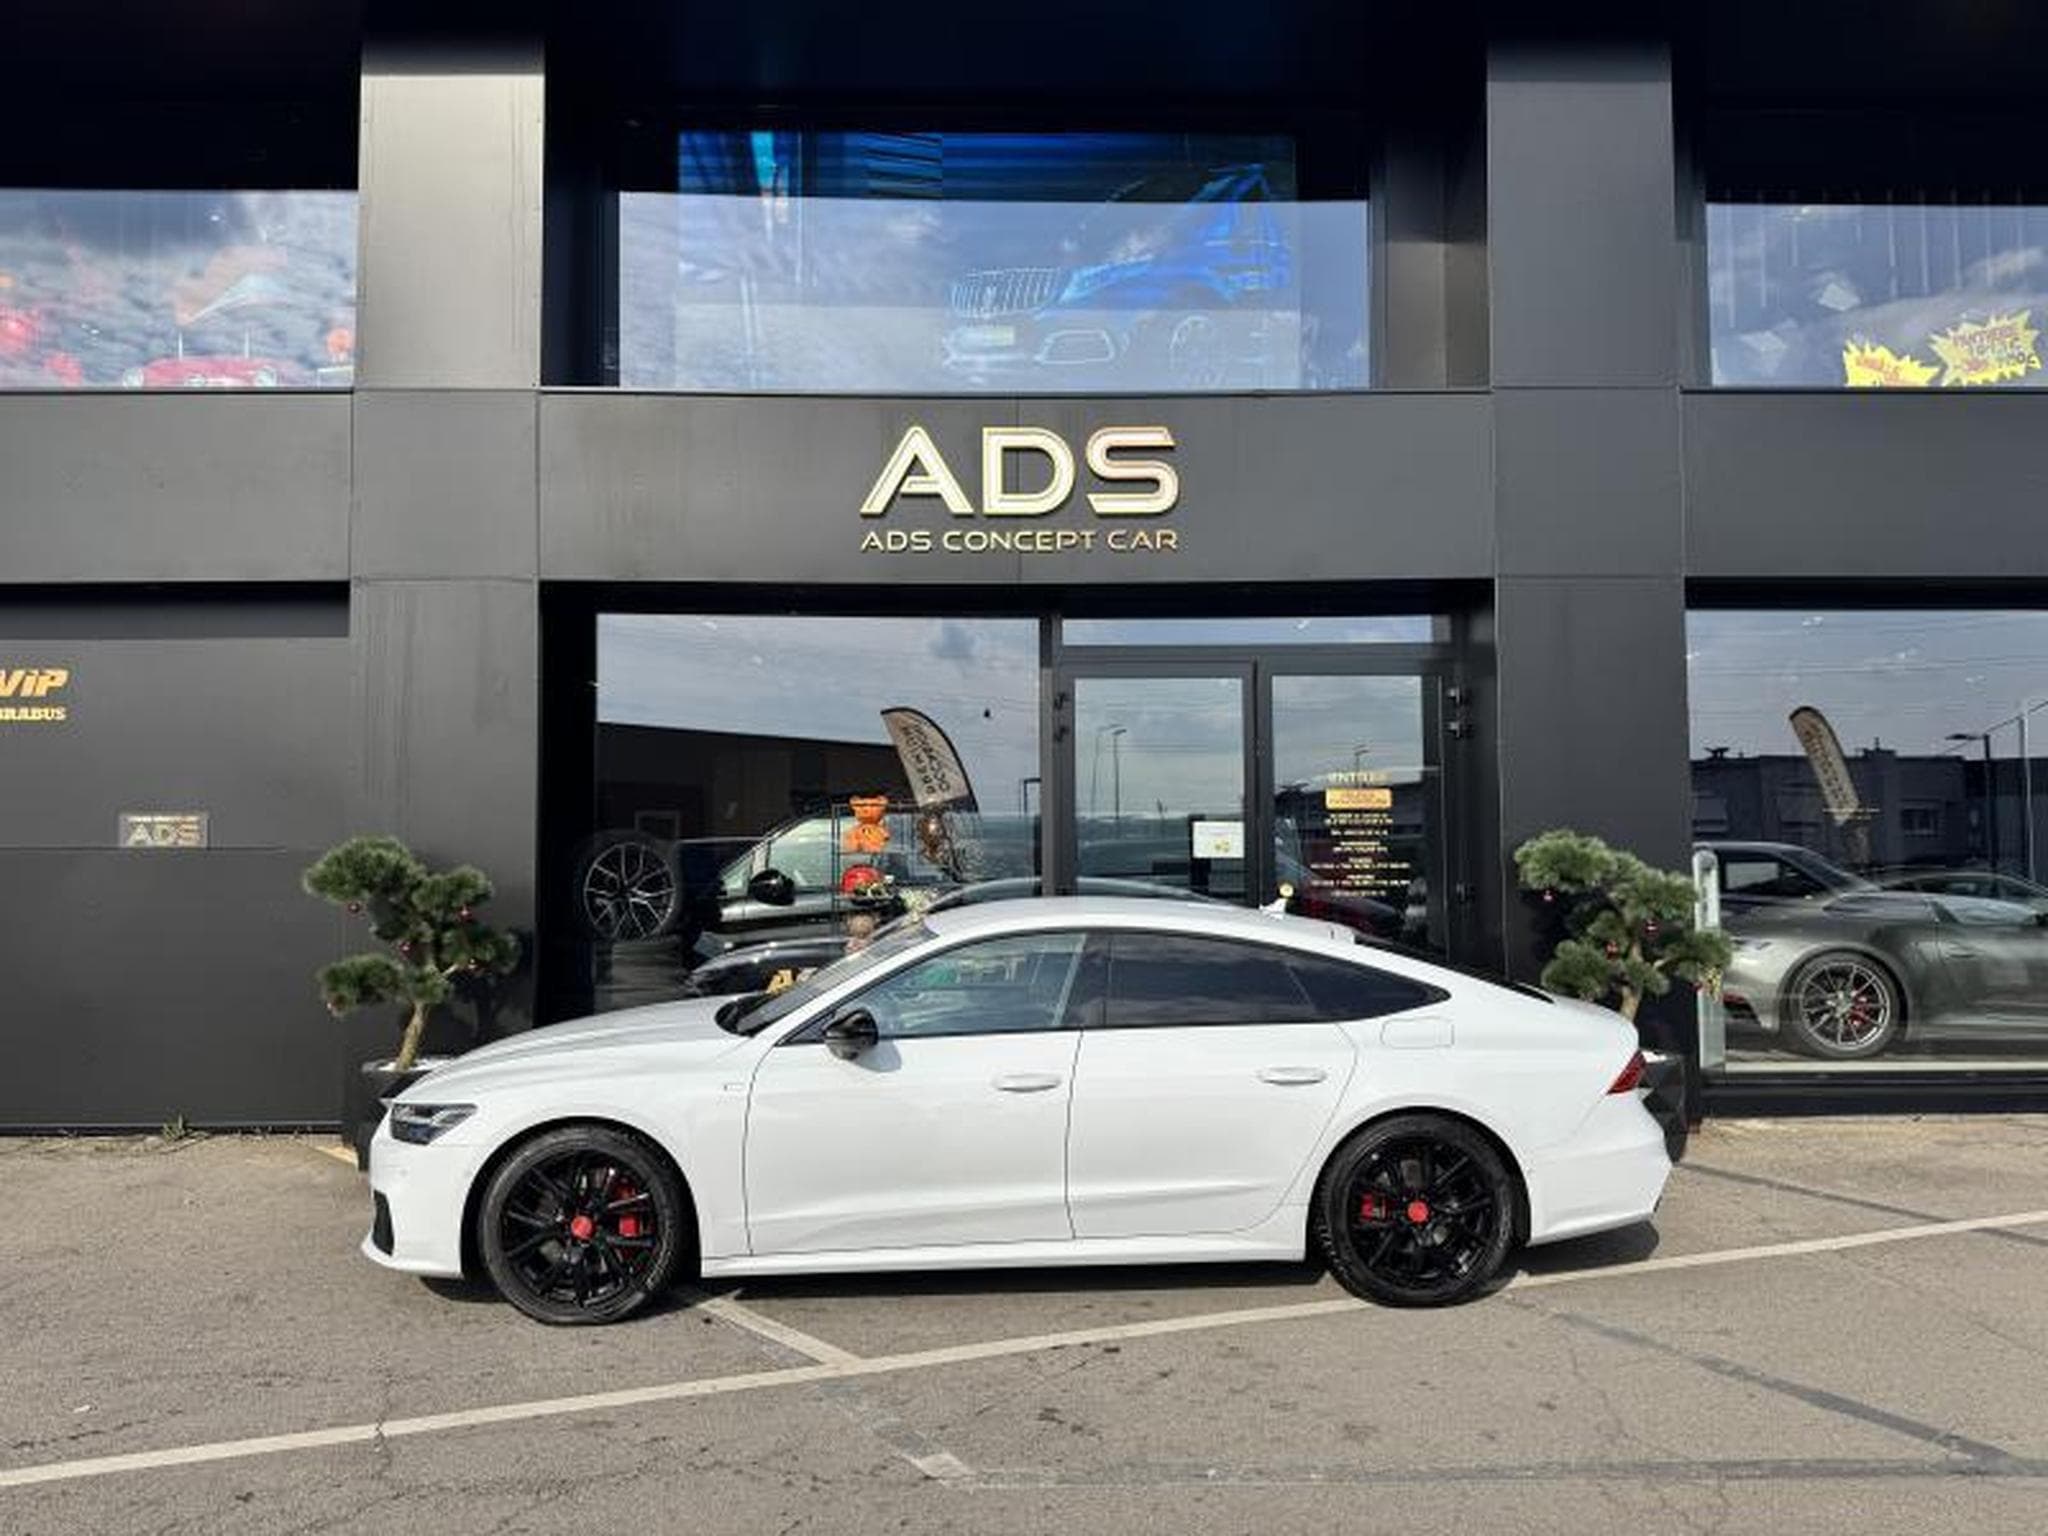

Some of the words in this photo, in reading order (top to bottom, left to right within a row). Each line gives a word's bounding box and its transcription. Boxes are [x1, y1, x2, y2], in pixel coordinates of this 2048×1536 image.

[860, 425, 1180, 516] ADS
[861, 531, 930, 551] ADS
[942, 530, 1096, 551] CONCEPT
[1106, 530, 1179, 551] CAR
